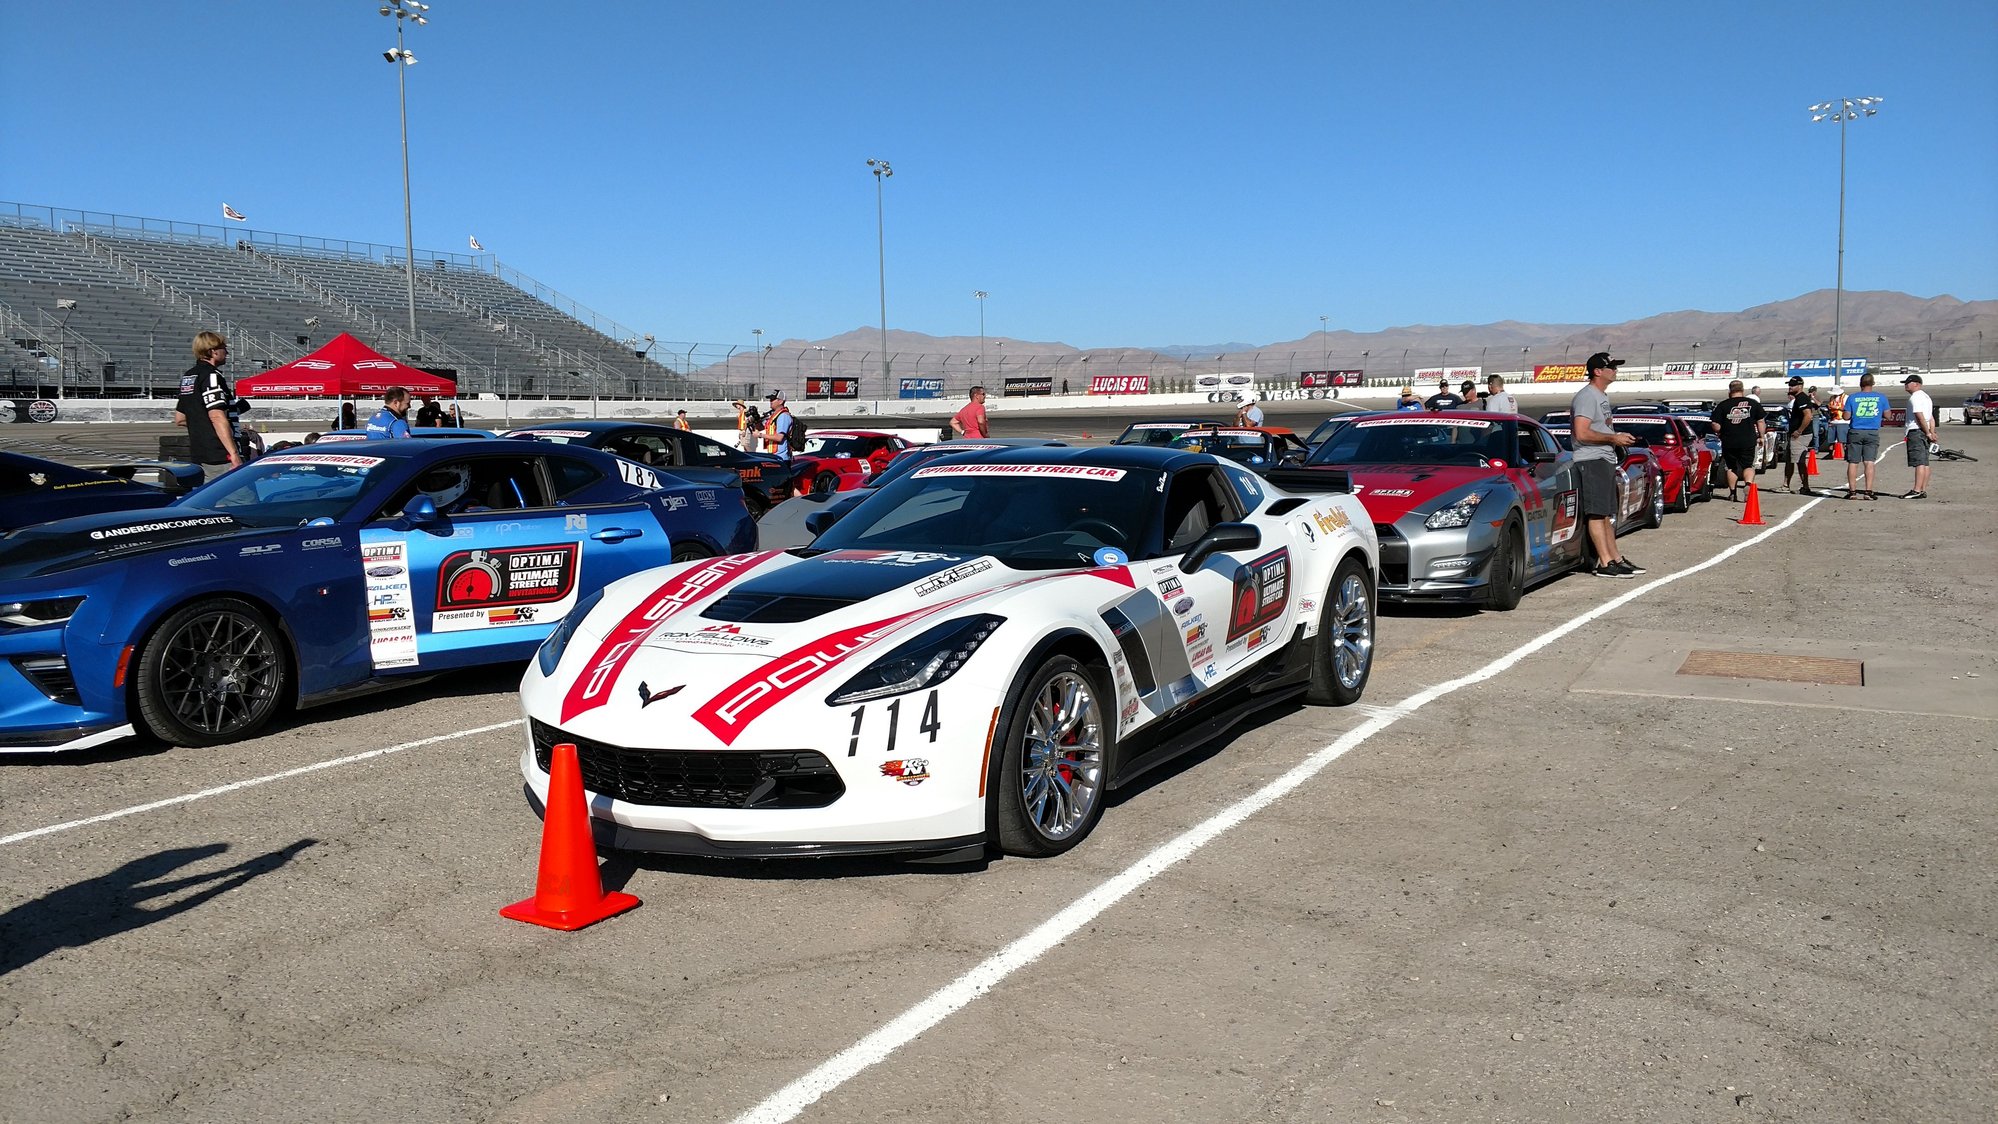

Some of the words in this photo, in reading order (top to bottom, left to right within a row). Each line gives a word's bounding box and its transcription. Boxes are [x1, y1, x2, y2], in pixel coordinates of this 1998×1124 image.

[353, 361, 398, 371] PS
[1541, 365, 1584, 374] Advance
[1702, 363, 1732, 371] OPTIMA
[1789, 359, 1867, 369] FALKEN
[252, 385, 325, 393] POWERSTOP
[1093, 377, 1127, 392] LUCAS
[1129, 377, 1147, 391] OIL
[1266, 390, 1309, 401] VEGAS
[1326, 389, 1335, 399] 4
[1856, 401, 1878, 417] 63
[621, 461, 659, 489] 782
[919, 464, 966, 475] OPTIMA
[967, 465, 1032, 474] ULTIMATE
[1035, 465, 1085, 475] STREET
[1086, 467, 1118, 478] CAR
[301, 536, 342, 548] CORSA
[363, 545, 401, 557] OPTIMA
[168, 553, 211, 567] Continental
[511, 554, 562, 569] OPTIMA
[1077, 552, 1092, 563] A
[510, 568, 560, 582] ULTIMATE
[367, 583, 408, 591] FALKEN
[509, 579, 541, 590] STREET
[541, 578, 559, 587] CAR
[1263, 579, 1285, 597] ULTIMATE
[508, 587, 558, 598] INVITATIONAL
[438, 611, 475, 621] Presented
[694, 632, 773, 646] FELLOWS
[848, 689, 941, 758] 114
